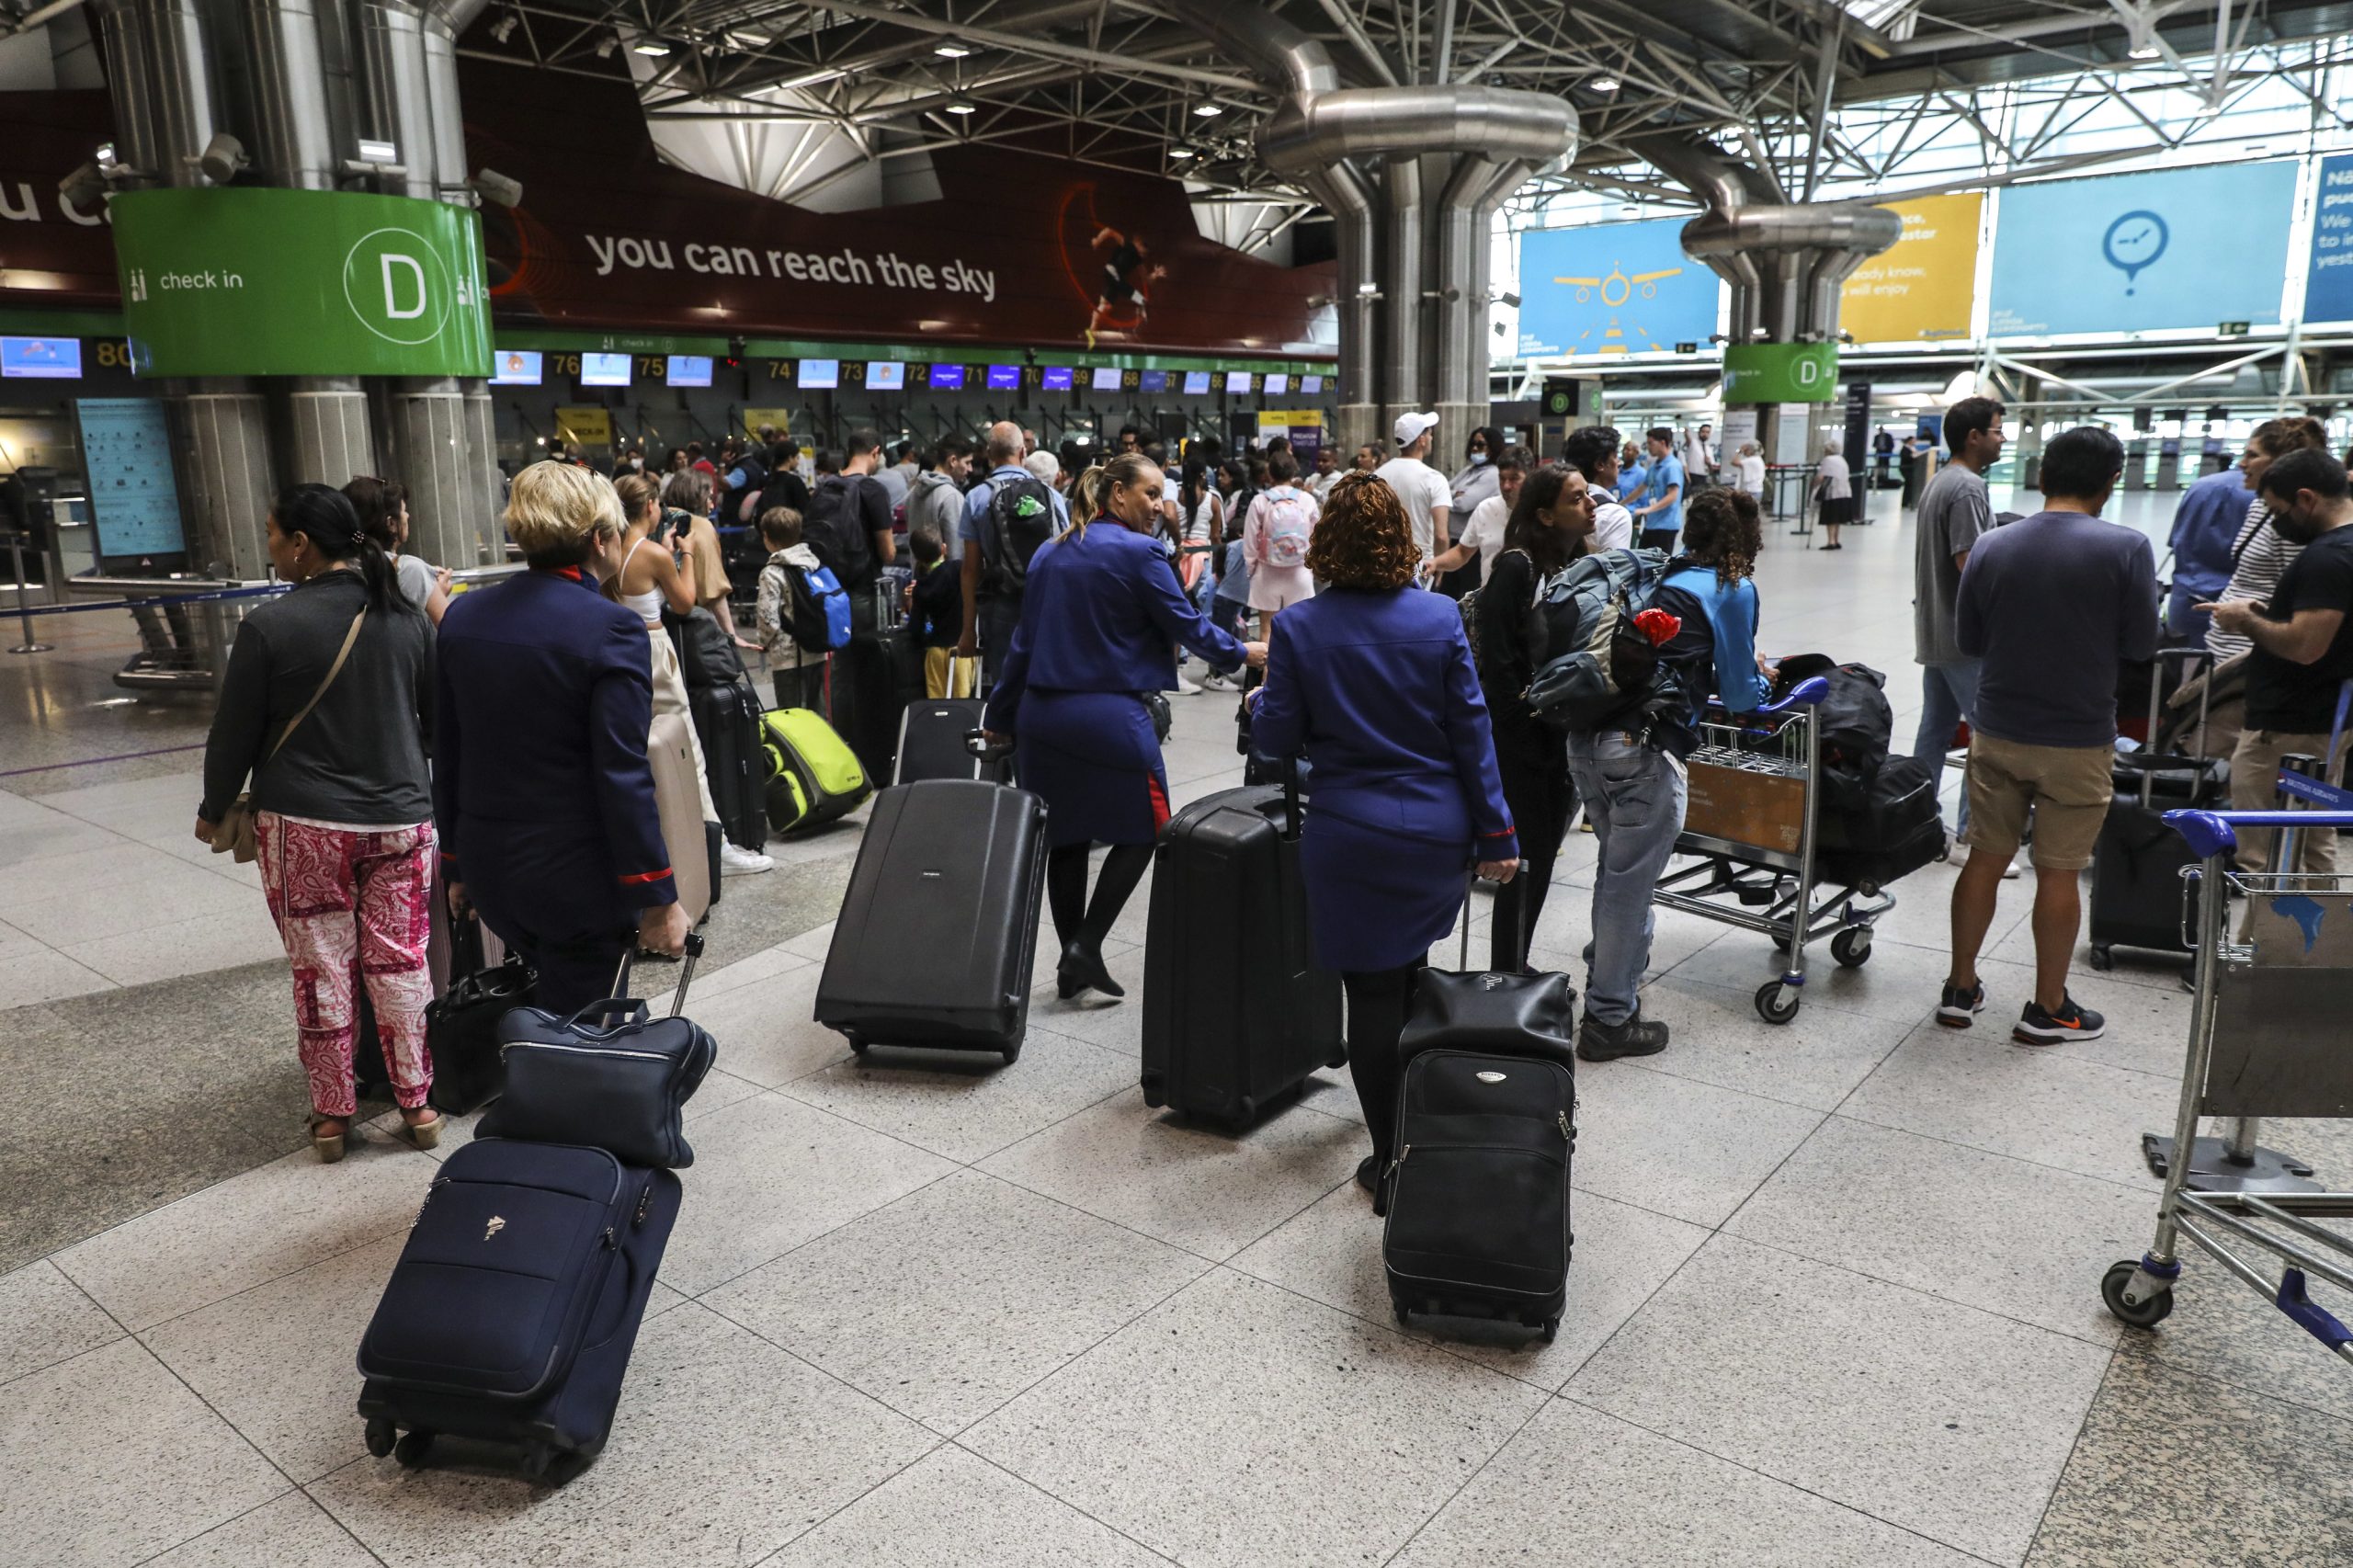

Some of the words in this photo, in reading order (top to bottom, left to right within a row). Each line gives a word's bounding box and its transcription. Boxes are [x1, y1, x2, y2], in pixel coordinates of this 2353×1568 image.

[58, 190, 112, 226] c
[585, 234, 675, 276] you
[684, 243, 761, 277] can
[767, 248, 873, 285] reach
[876, 253, 937, 290] the
[941, 259, 995, 302] sky
[160, 270, 218, 290] check
[222, 269, 244, 288] in
[380, 253, 426, 319] D
[552, 355, 580, 375] 76
[639, 358, 665, 377] 75
[768, 361, 791, 380] 74
[842, 363, 863, 381] 73
[908, 365, 926, 381] 72
[1800, 360, 1817, 383] D
[967, 368, 983, 382] 71
[1025, 369, 1040, 384] 70
[1073, 369, 1089, 384] 69
[1123, 371, 1139, 386] 68
